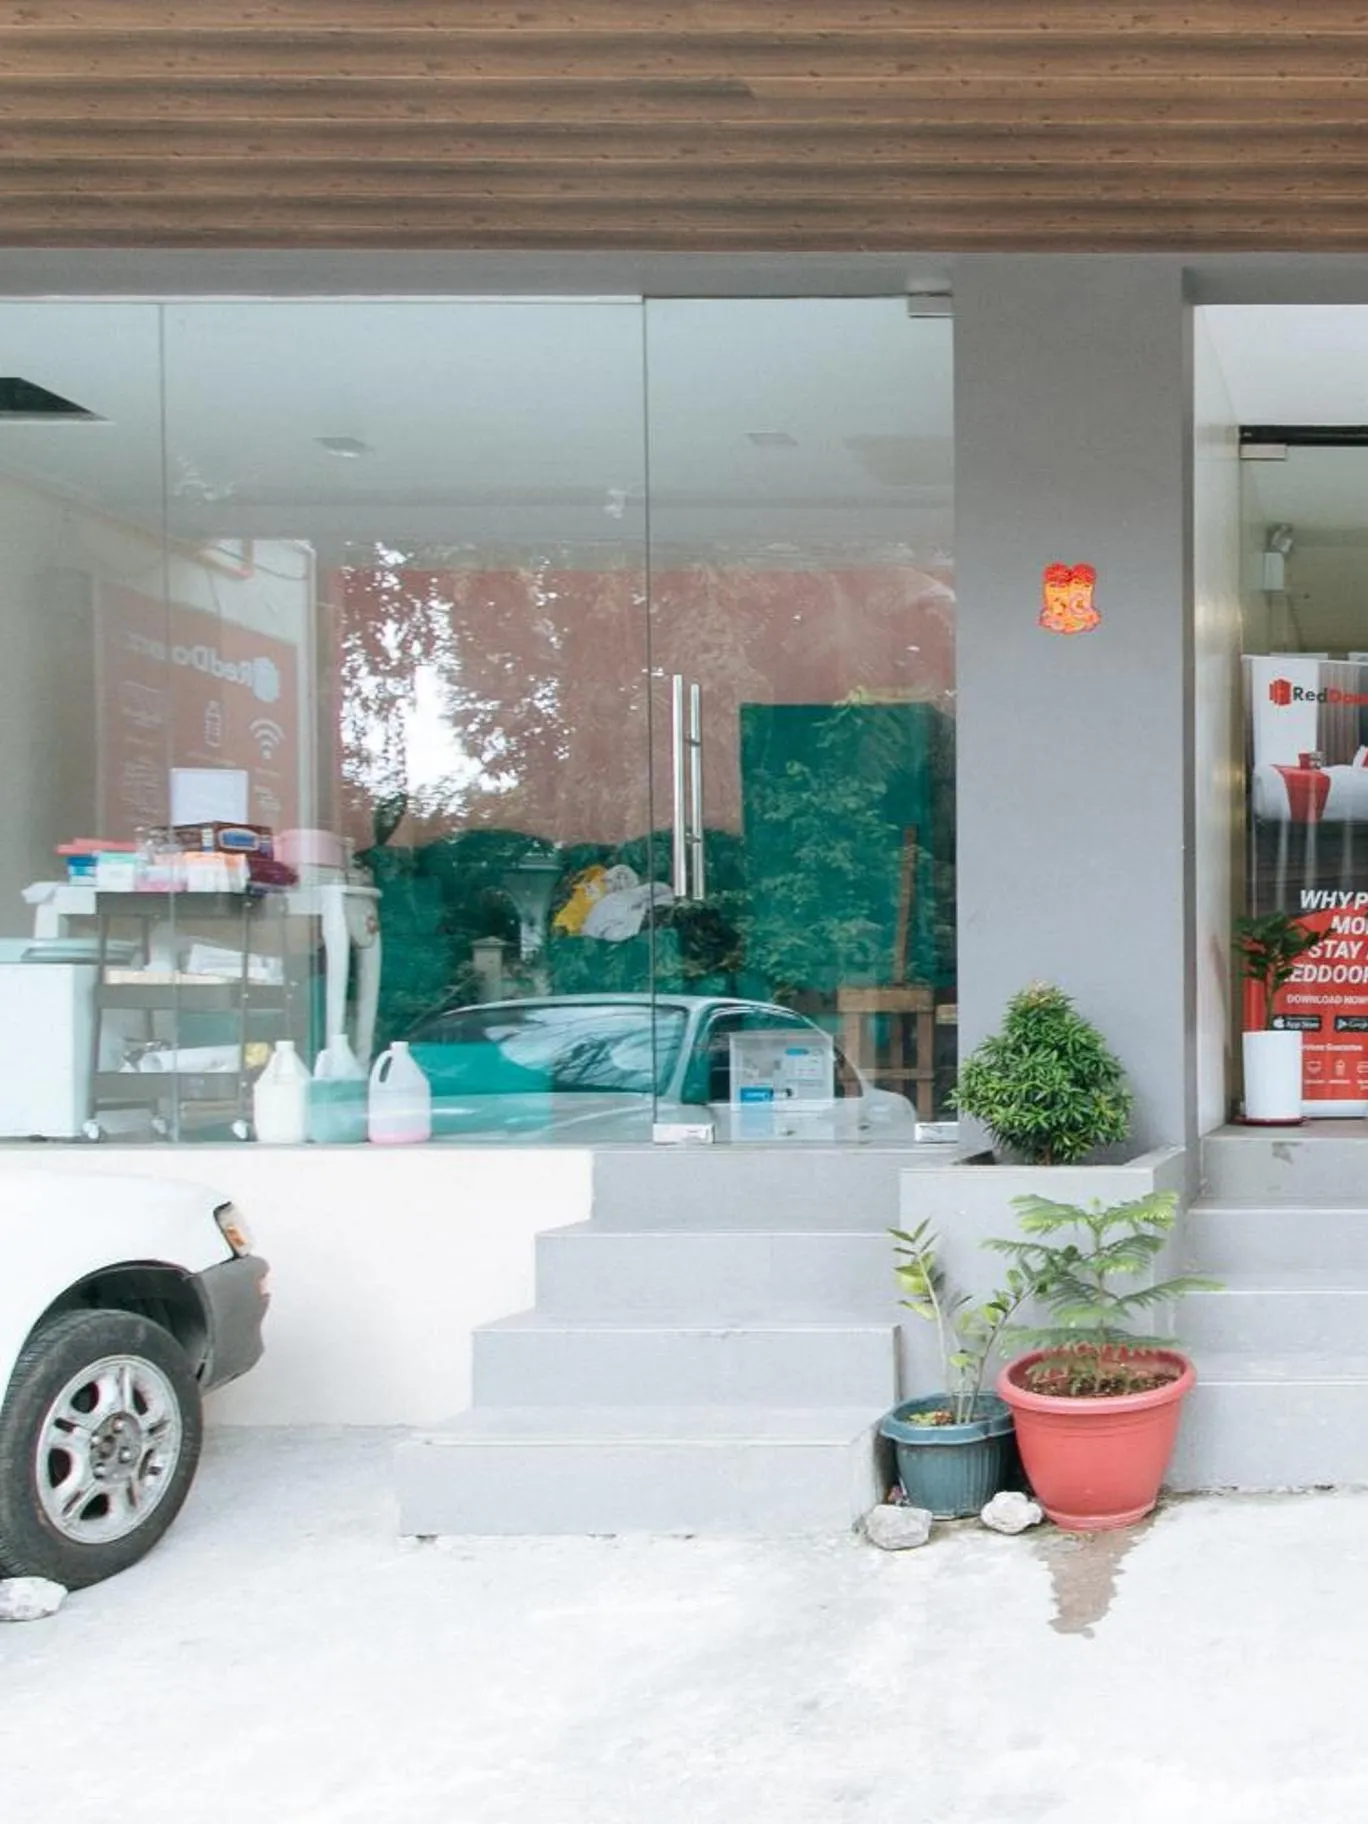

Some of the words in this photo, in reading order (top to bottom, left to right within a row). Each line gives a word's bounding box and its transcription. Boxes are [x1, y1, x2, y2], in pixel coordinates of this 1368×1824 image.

[1300, 890, 1354, 910] WHY
[1308, 940, 1364, 960] STAY
[1286, 994, 1343, 1005] DOWNLOAD
